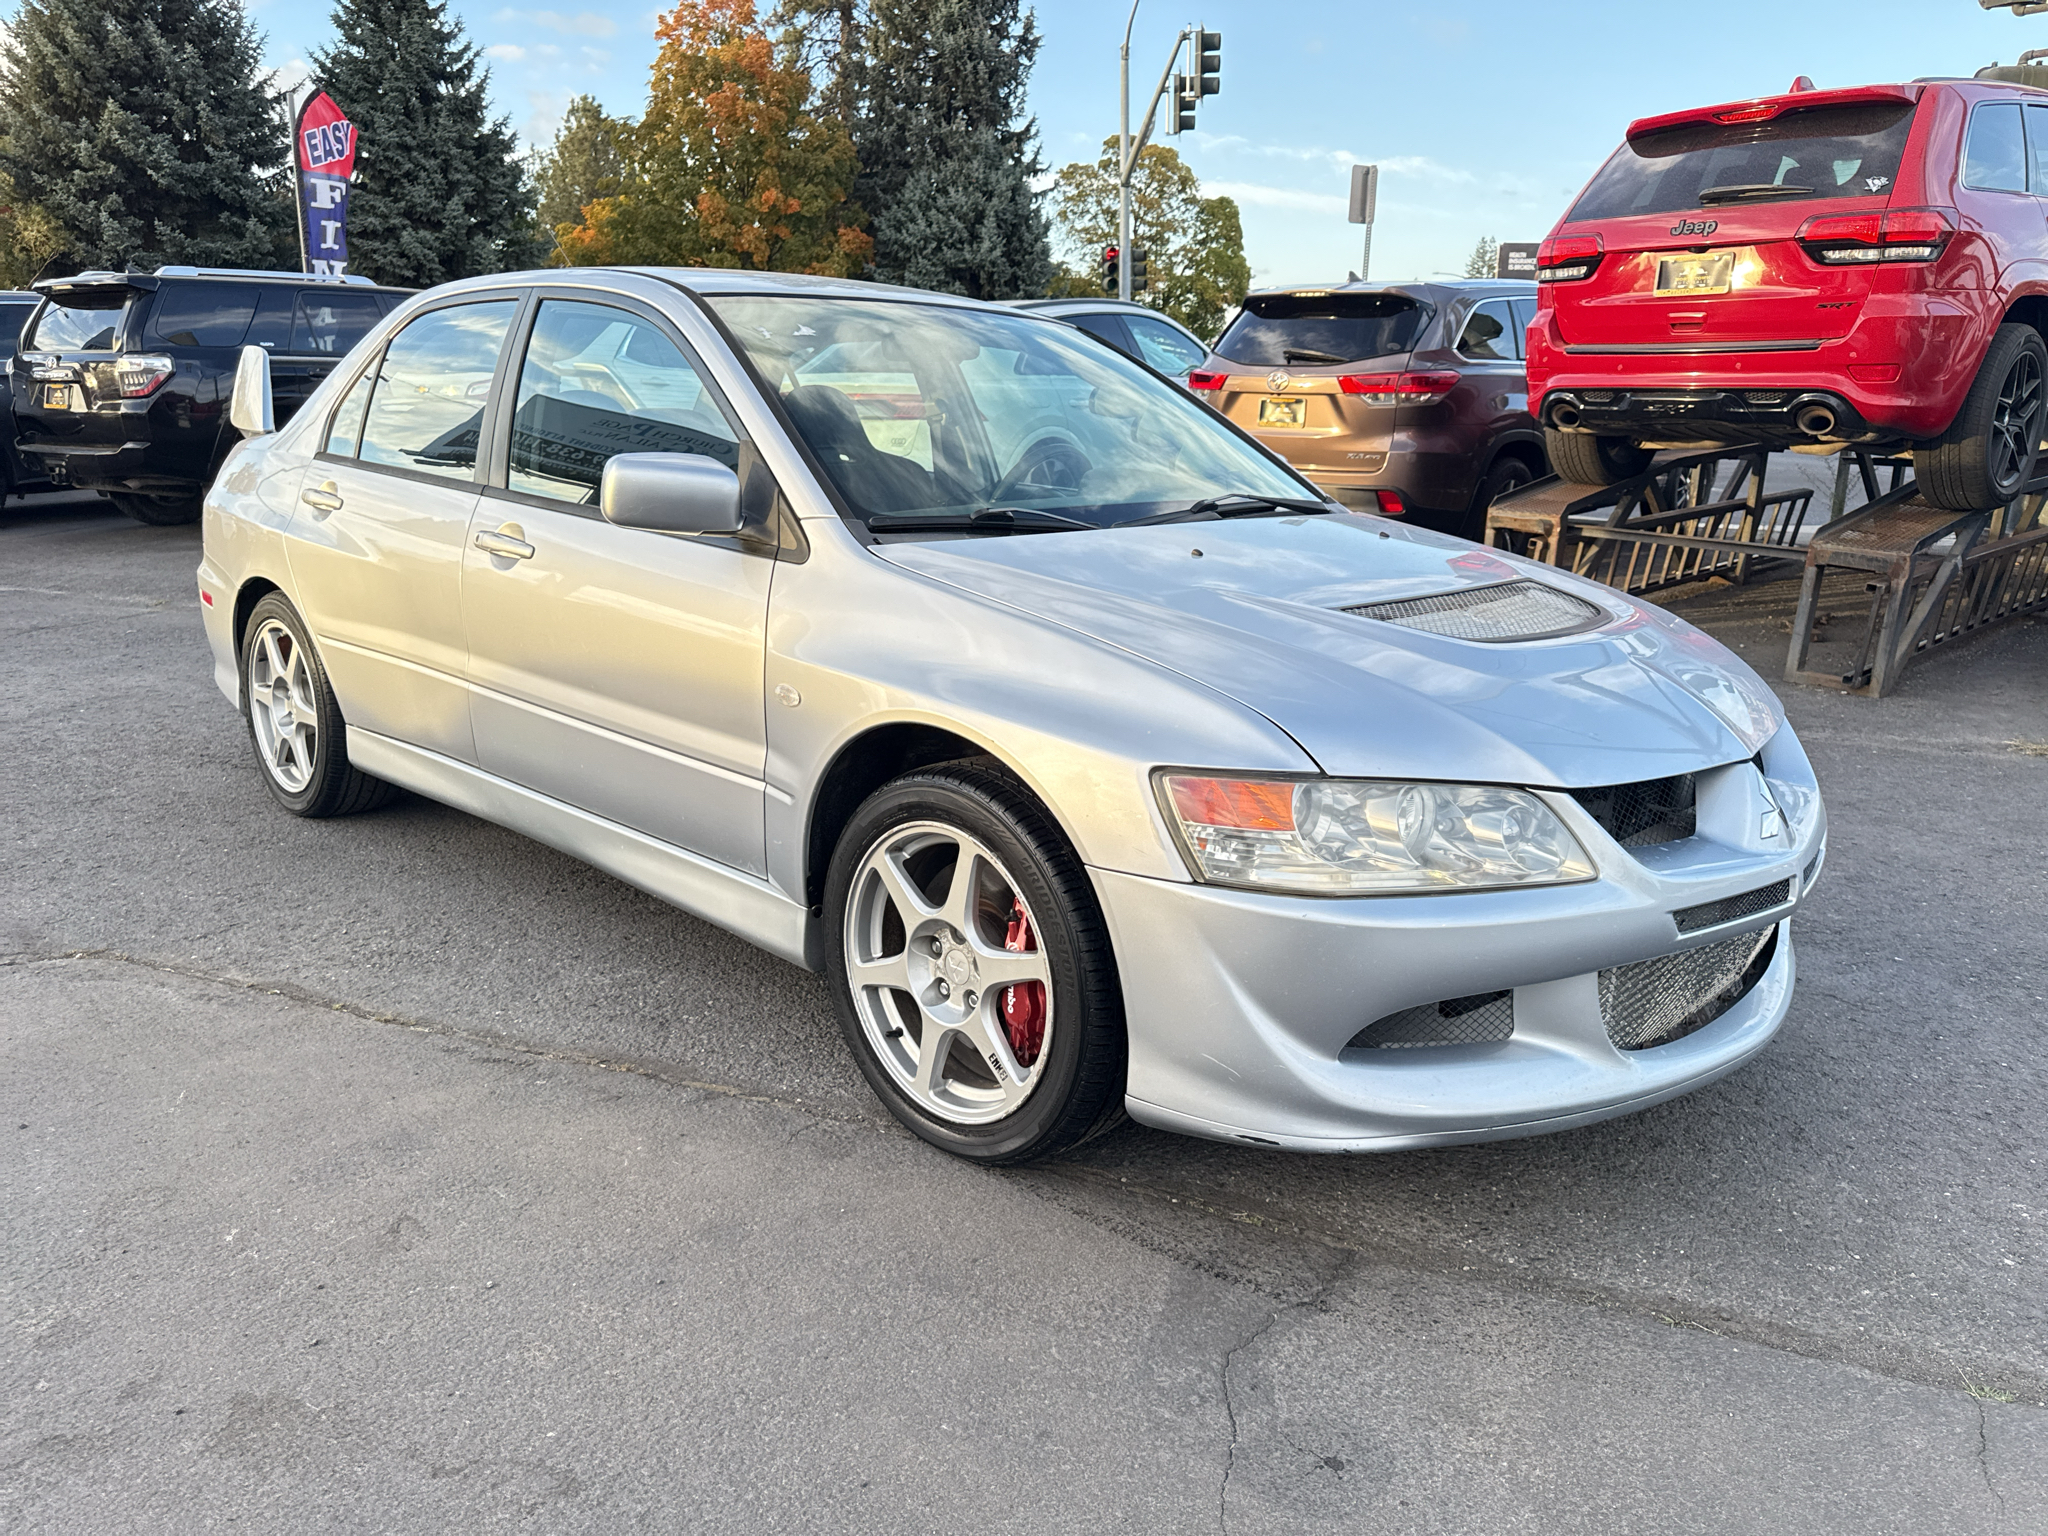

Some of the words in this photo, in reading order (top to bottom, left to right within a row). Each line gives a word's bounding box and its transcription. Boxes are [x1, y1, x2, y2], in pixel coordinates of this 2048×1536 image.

[304, 119, 352, 168] EASY
[1670, 219, 1718, 237] Jeep
[1814, 300, 1858, 310] SRT
[1643, 403, 1695, 415] SRT
[1018, 857, 1076, 998] BRIDGESTONE
[1008, 985, 1016, 1013] mbo
[988, 1053, 1009, 1081] ENKEI
